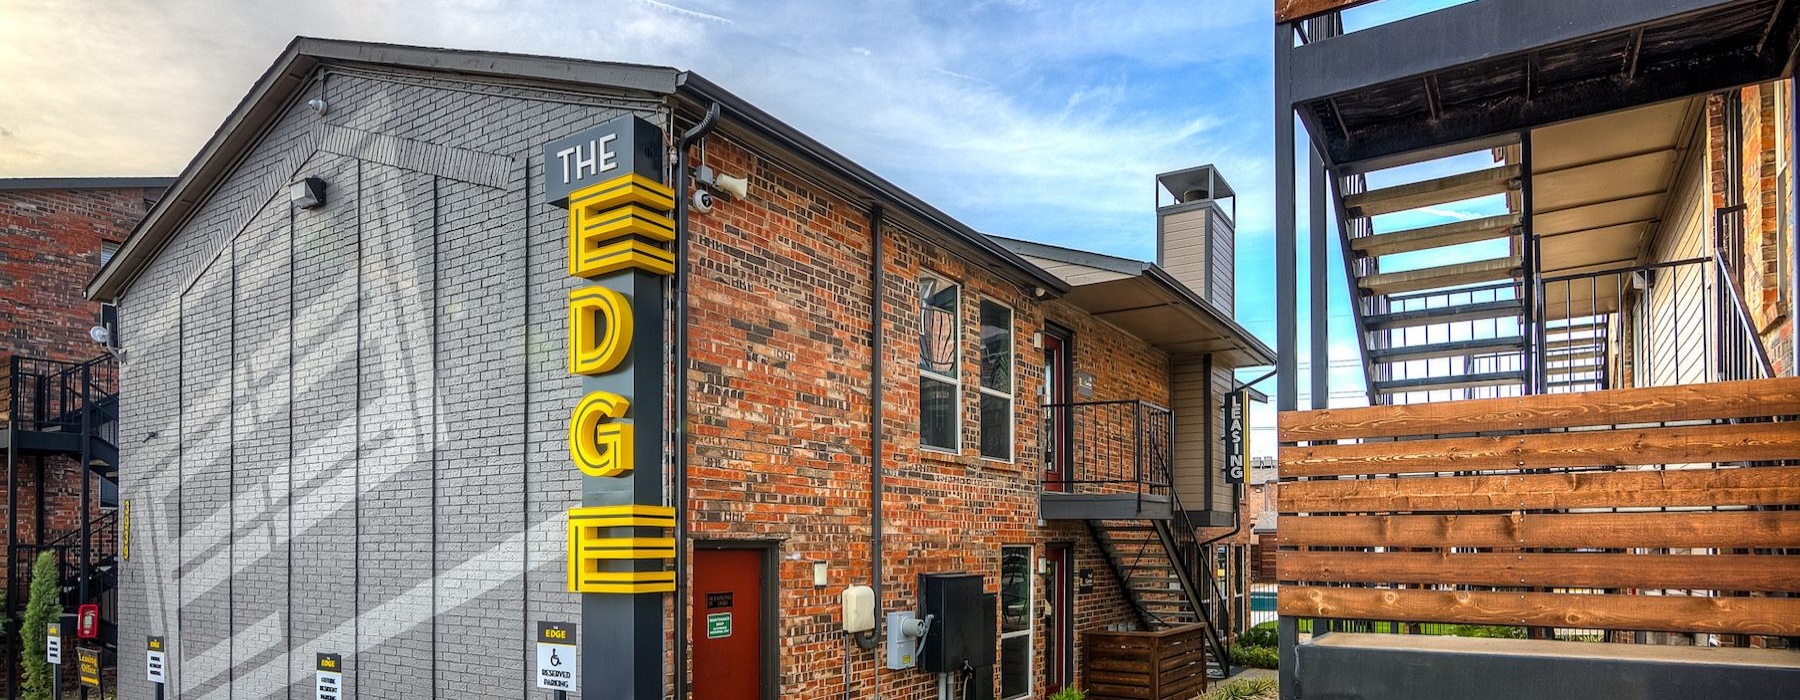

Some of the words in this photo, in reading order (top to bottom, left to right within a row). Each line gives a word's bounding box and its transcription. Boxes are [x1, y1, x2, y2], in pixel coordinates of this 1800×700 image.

[557, 133, 618, 184] THE
[568, 173, 676, 594] EDGE
[1230, 395, 1243, 478] LEASING
[545, 629, 567, 639] EDGE
[78, 652, 97, 667] Leasing
[321, 659, 336, 668] EDGE
[81, 663, 97, 675] Office
[541, 668, 571, 679] RESERVED
[543, 678, 569, 688] PARKING
